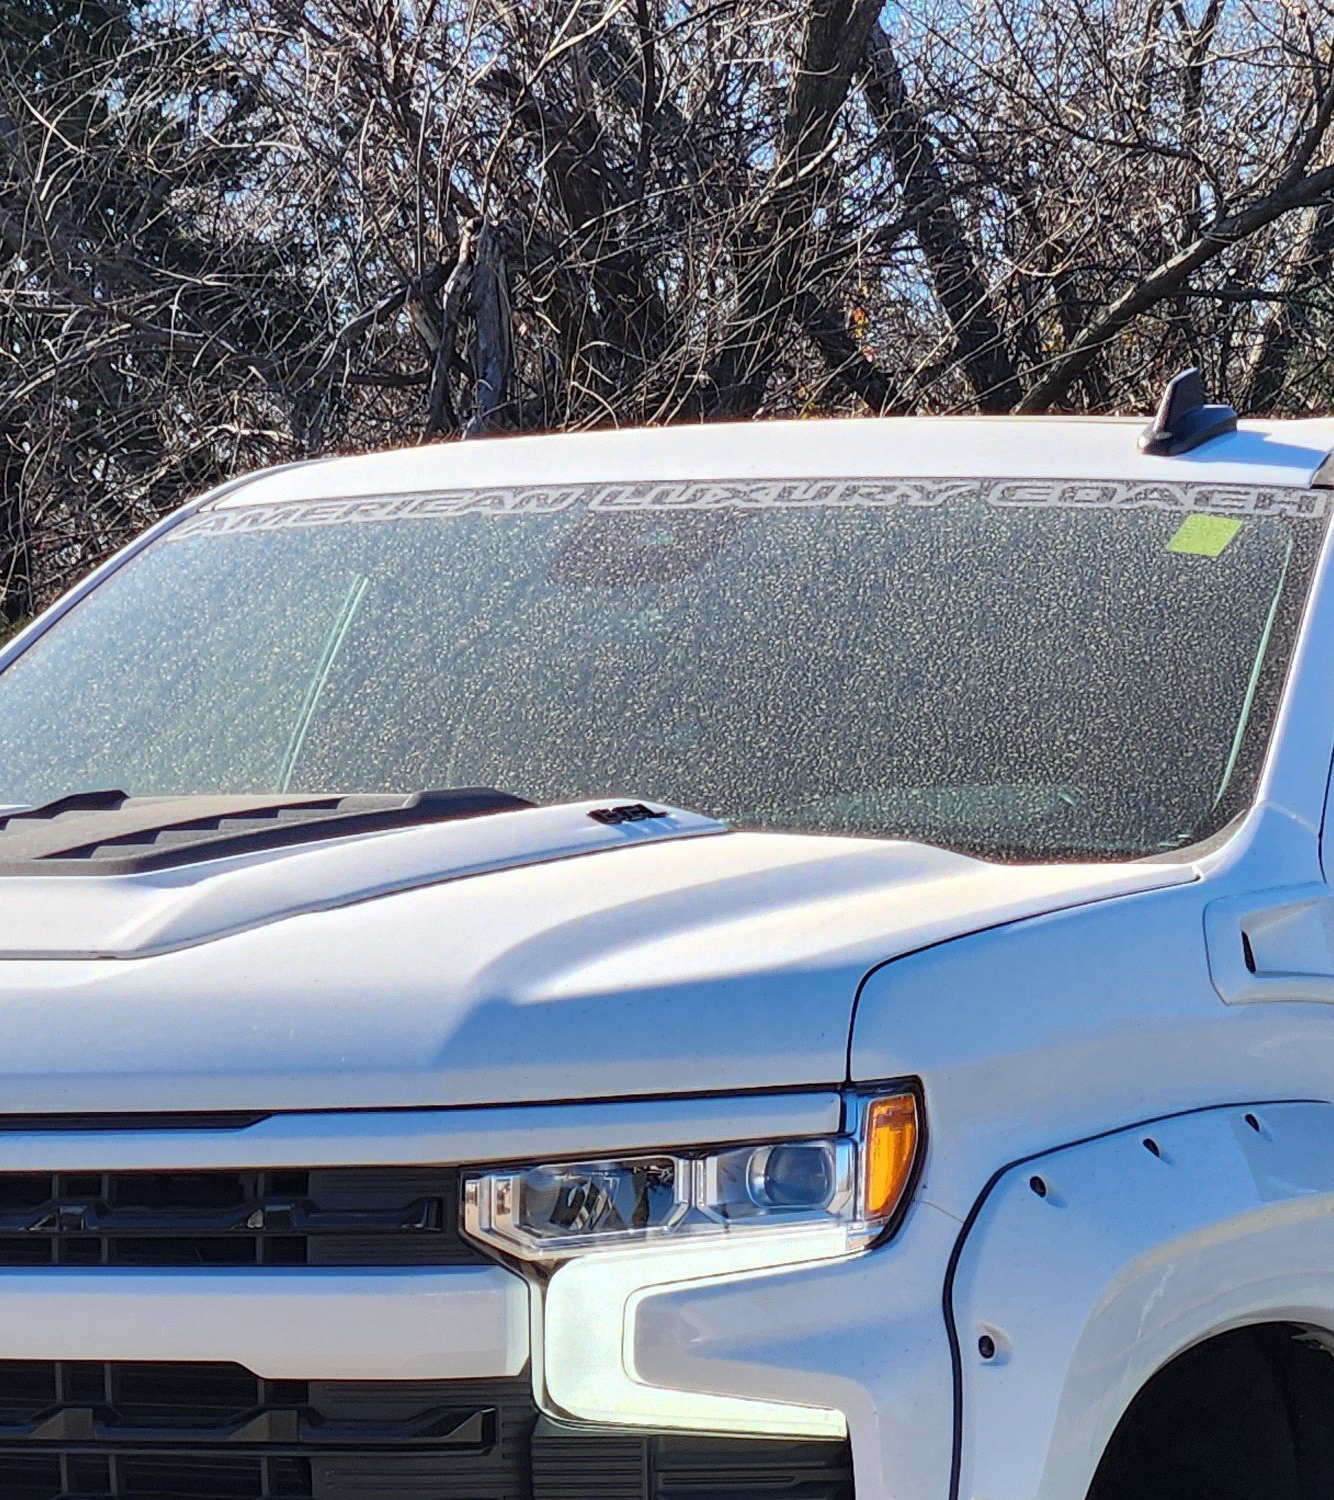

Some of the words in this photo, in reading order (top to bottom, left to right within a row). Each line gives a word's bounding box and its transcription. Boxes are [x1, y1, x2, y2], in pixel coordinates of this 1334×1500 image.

[167, 490, 567, 541] AMERICAN
[588, 480, 979, 511] LUXURY
[986, 482, 1328, 519] COACH
